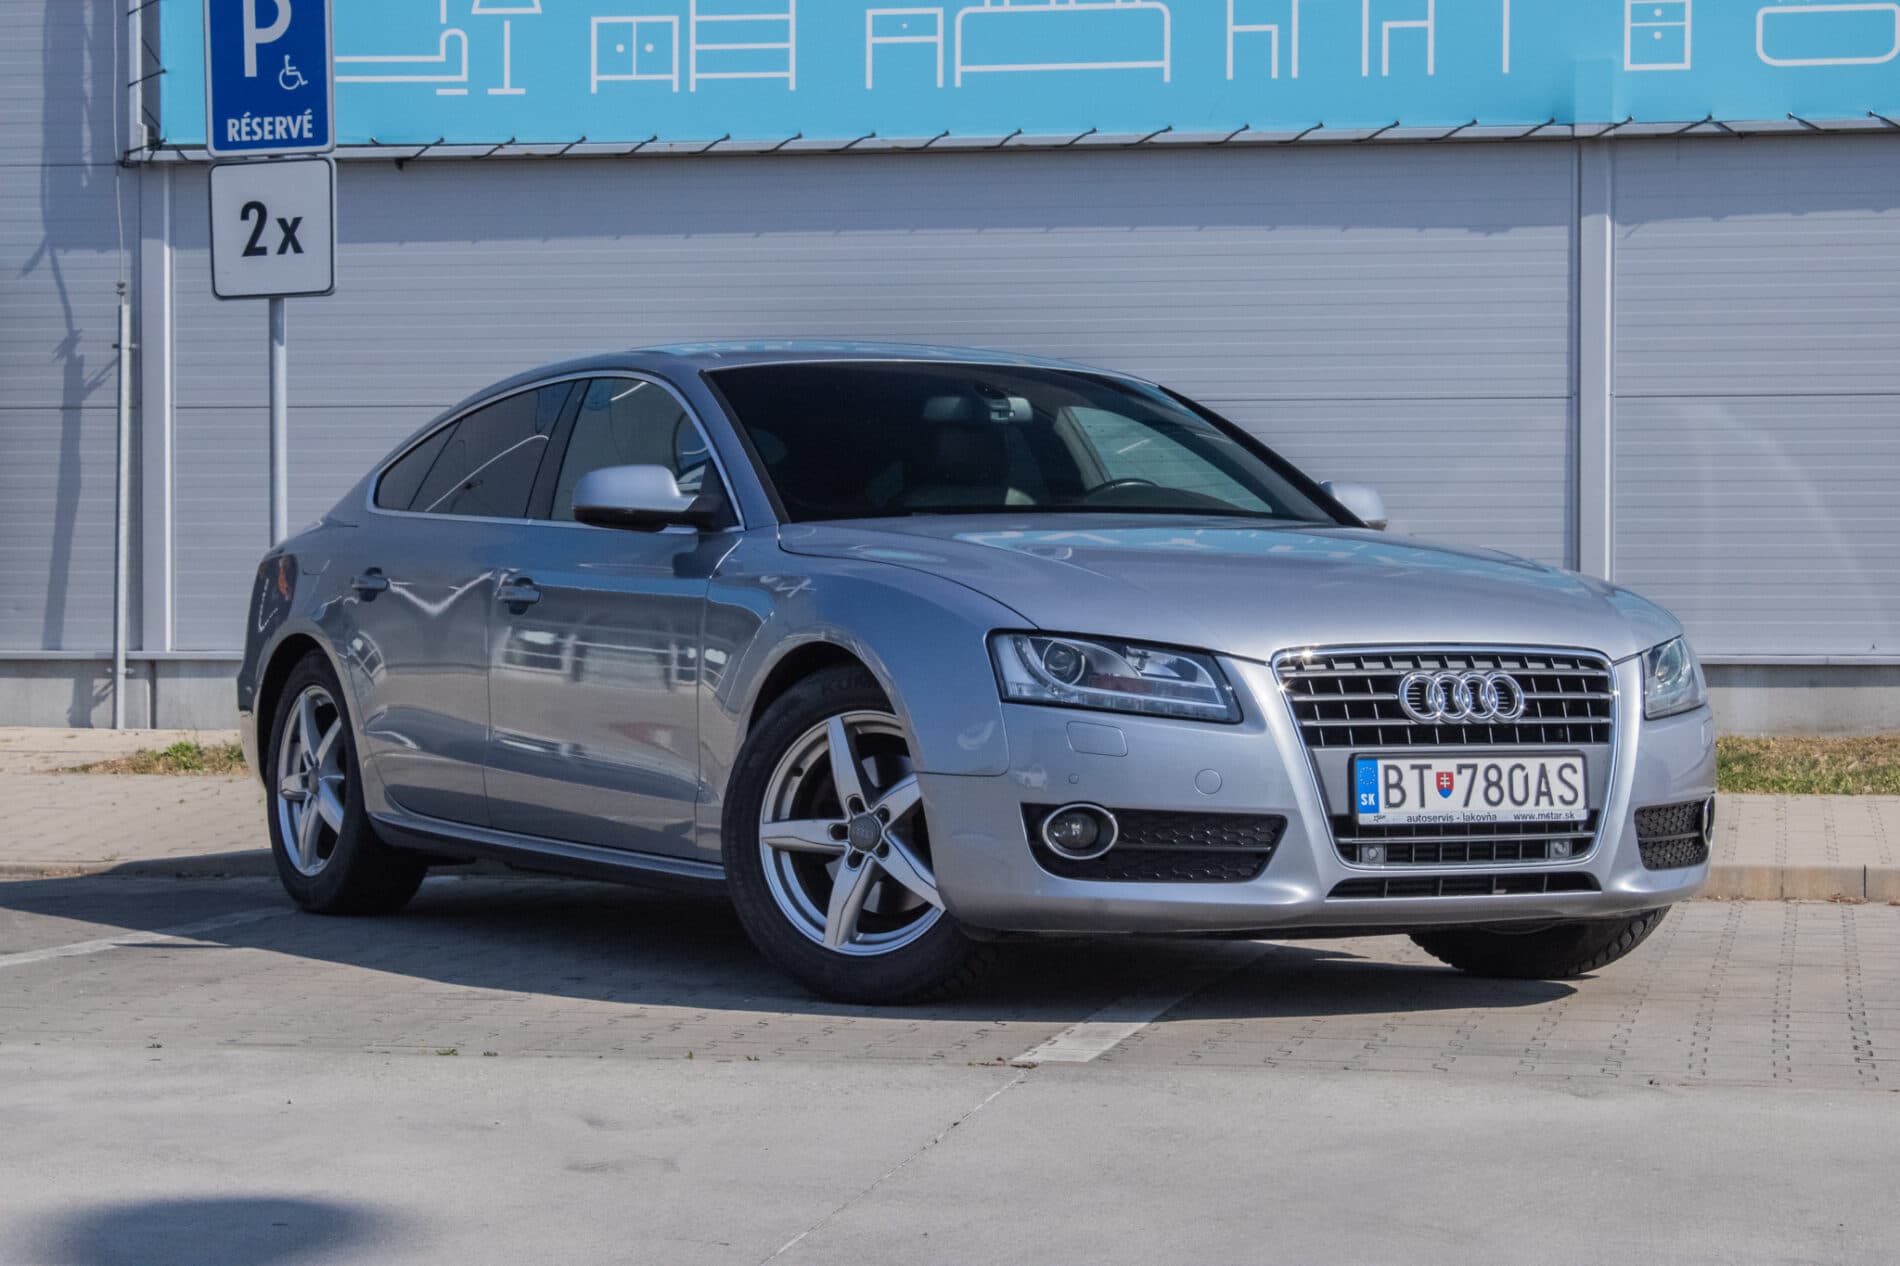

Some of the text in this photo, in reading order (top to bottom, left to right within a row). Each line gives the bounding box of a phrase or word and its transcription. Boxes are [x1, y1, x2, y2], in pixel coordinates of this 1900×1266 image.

[242, 0, 292, 78] P
[227, 109, 314, 142] RÉSERVÉ
[240, 200, 305, 257] 2x
[1360, 793, 1376, 806] SK
[1383, 762, 1579, 809] BT 780AS
[1406, 812, 1454, 823] autoservis
